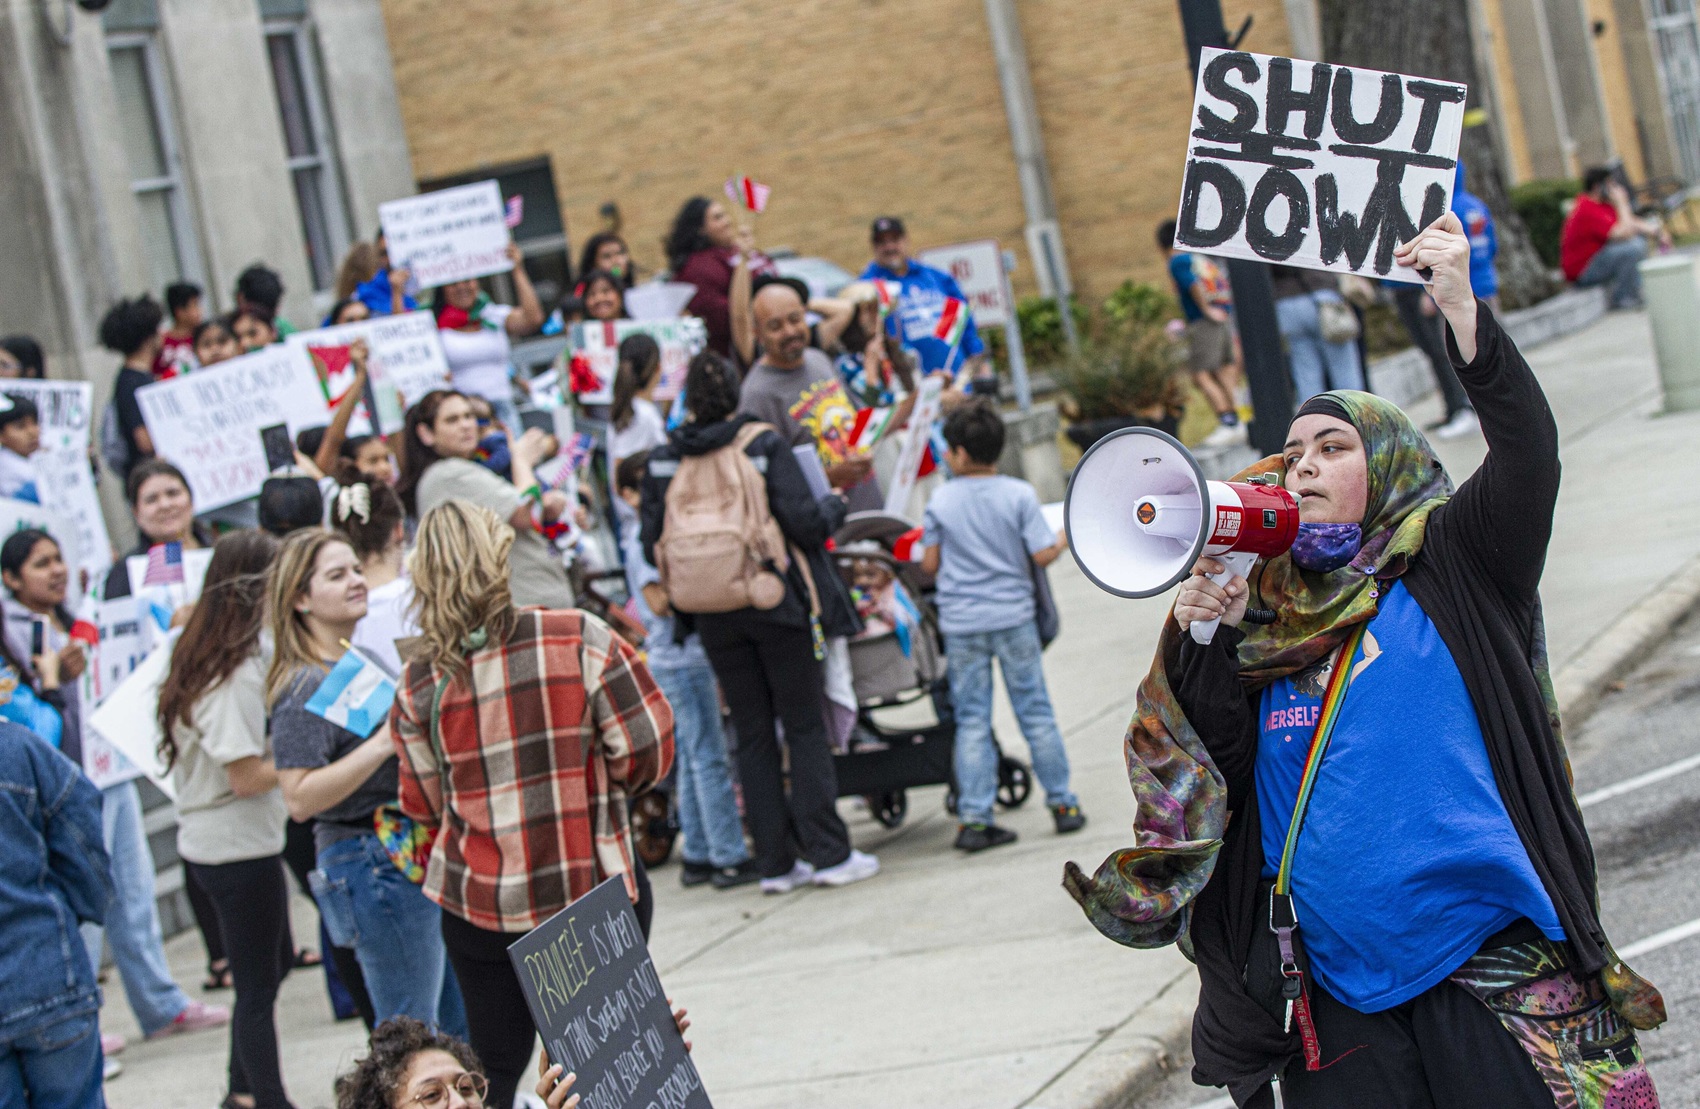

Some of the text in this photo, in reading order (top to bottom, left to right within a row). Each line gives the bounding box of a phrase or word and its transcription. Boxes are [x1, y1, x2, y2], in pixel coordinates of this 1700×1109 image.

[1198, 51, 1466, 153] SHUT
[1176, 158, 1446, 281] DOWN
[1264, 706, 1319, 733] HERSELF
[524, 916, 595, 1027] PRIVILEGE
[589, 924, 611, 966] IS
[564, 1015, 600, 1067] THINK
[634, 957, 661, 1002] NOT
[1300, 1015, 1313, 1038] BEFORE
